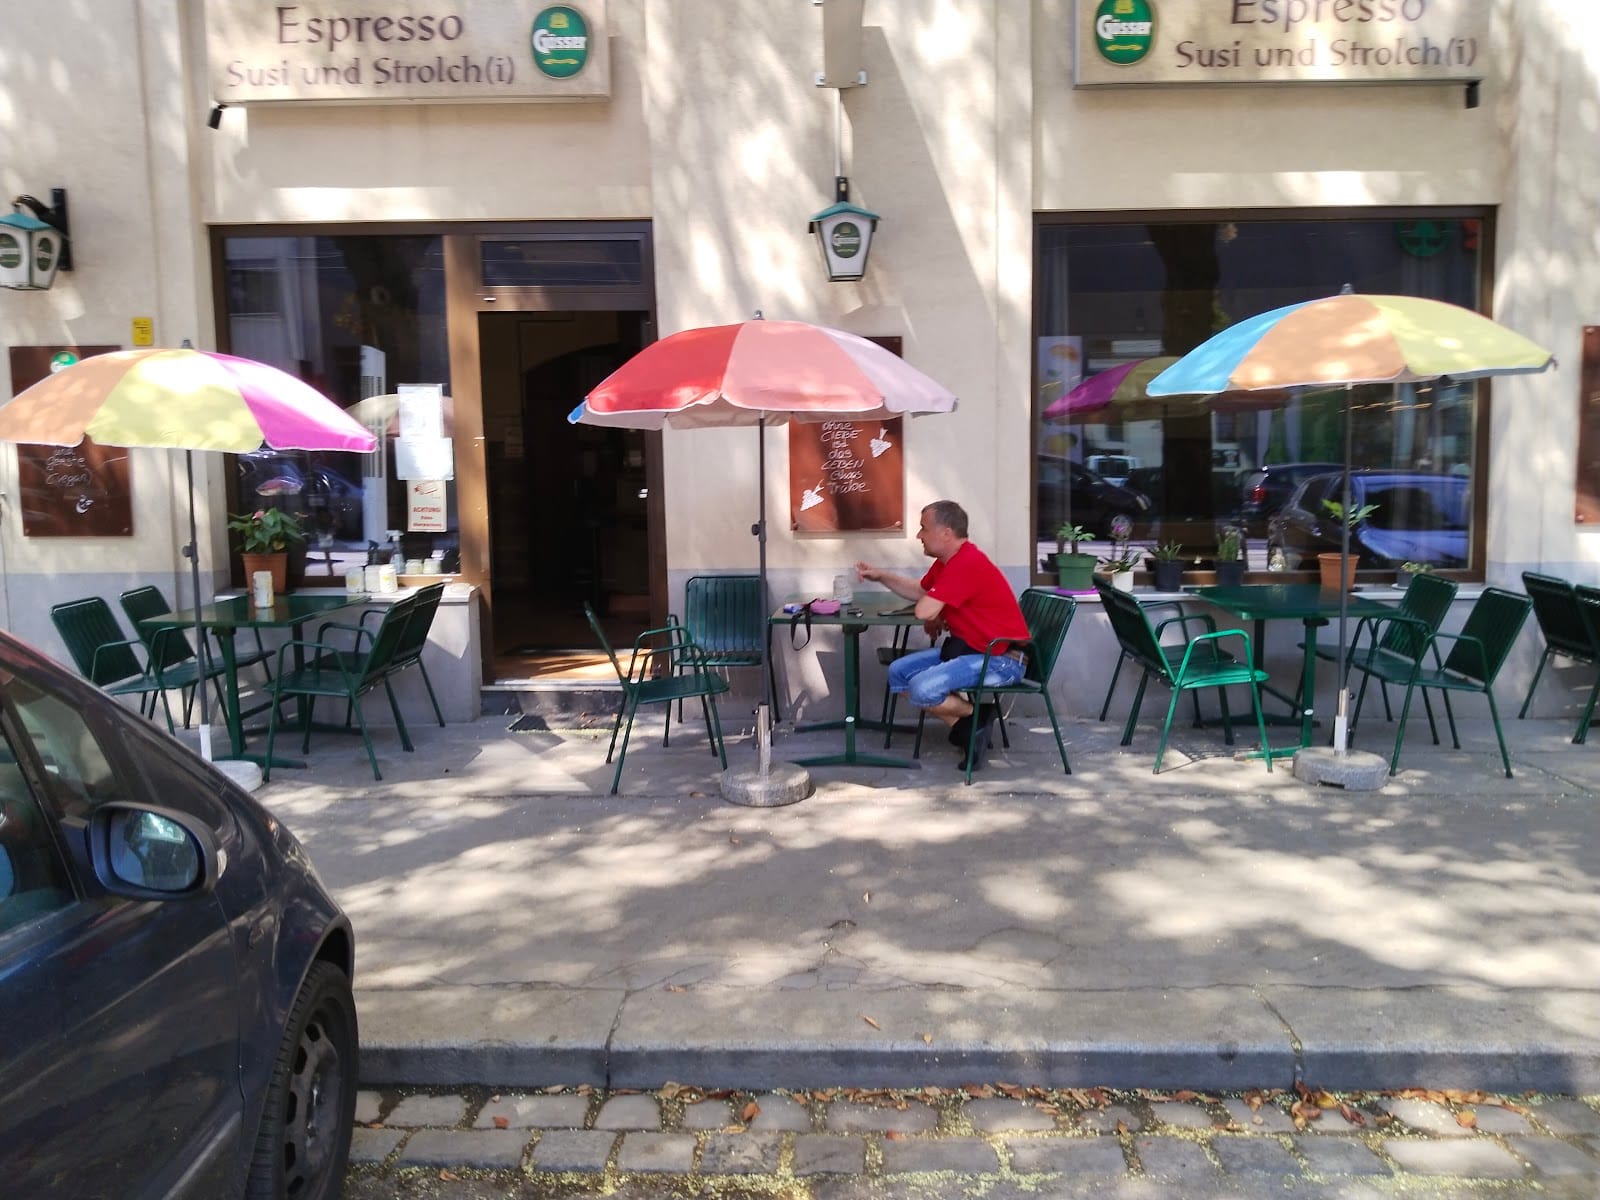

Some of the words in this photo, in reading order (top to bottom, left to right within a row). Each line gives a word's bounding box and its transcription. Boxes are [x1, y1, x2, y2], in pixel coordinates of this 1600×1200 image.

[276, 7, 464, 51] Espresso
[1231, 0, 1424, 31] Espresso
[1176, 40, 1240, 68] Susi
[1255, 39, 1315, 66] und
[1330, 37, 1478, 66] Strolch(i)
[227, 59, 289, 87] Susi
[304, 57, 362, 85] und
[373, 55, 515, 85] Strolch(i)
